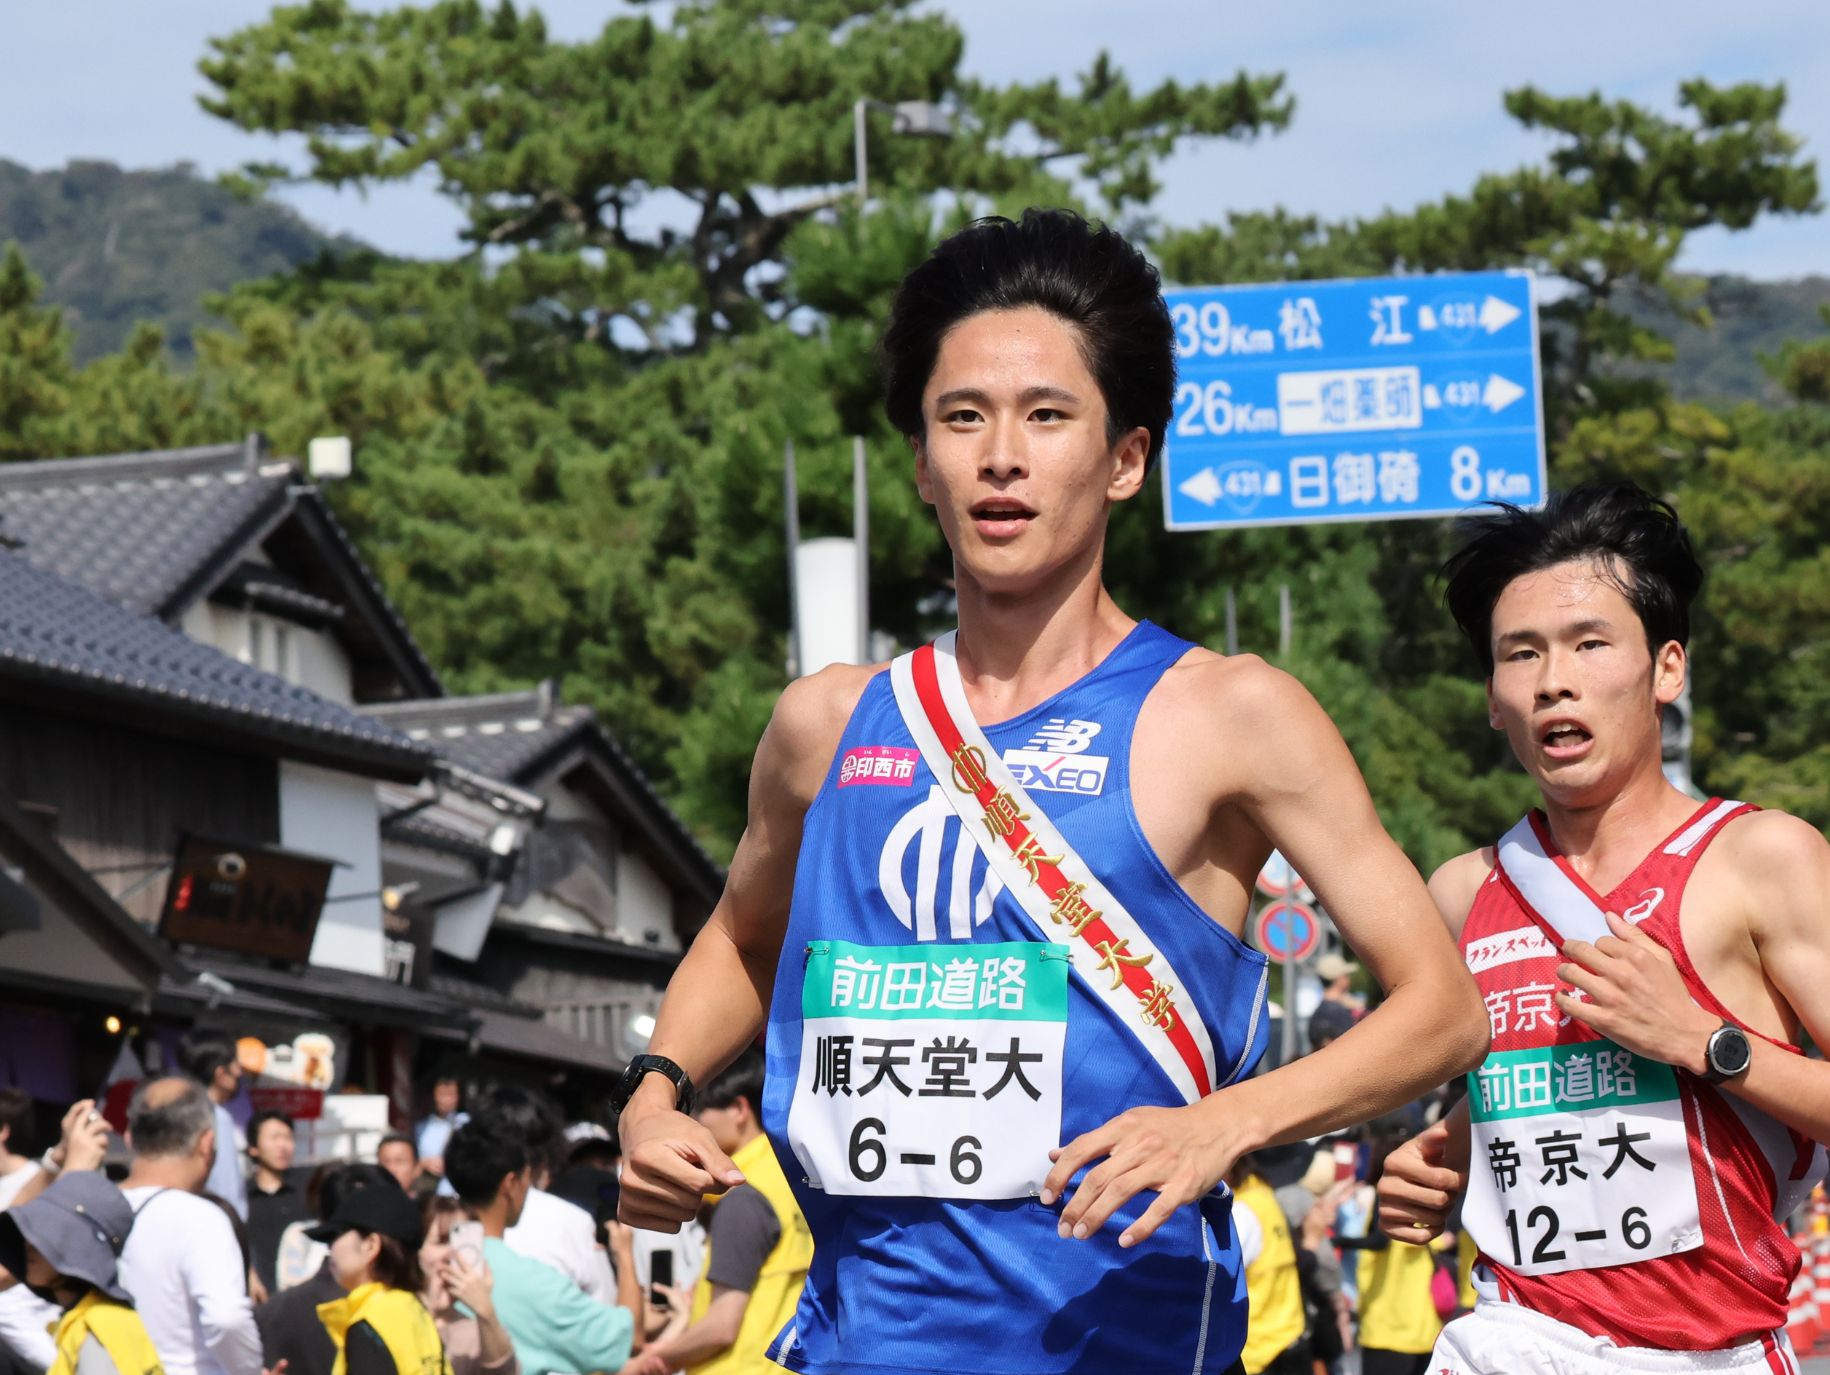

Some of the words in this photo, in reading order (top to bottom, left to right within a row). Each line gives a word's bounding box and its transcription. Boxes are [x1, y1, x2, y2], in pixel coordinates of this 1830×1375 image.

[1279, 295, 1414, 351] 松江
[855, 756, 916, 778] 印西市
[980, 785, 1177, 1033] 順天堂大学
[831, 954, 1027, 1011] 前田道路
[811, 1035, 1043, 1102] 順天堂大
[1478, 1050, 1638, 1112] 前田道路
[849, 1117, 983, 1185] 6-6
[1488, 1122, 1657, 1193] 帝京大
[1505, 1205, 1652, 1266] 12-6
